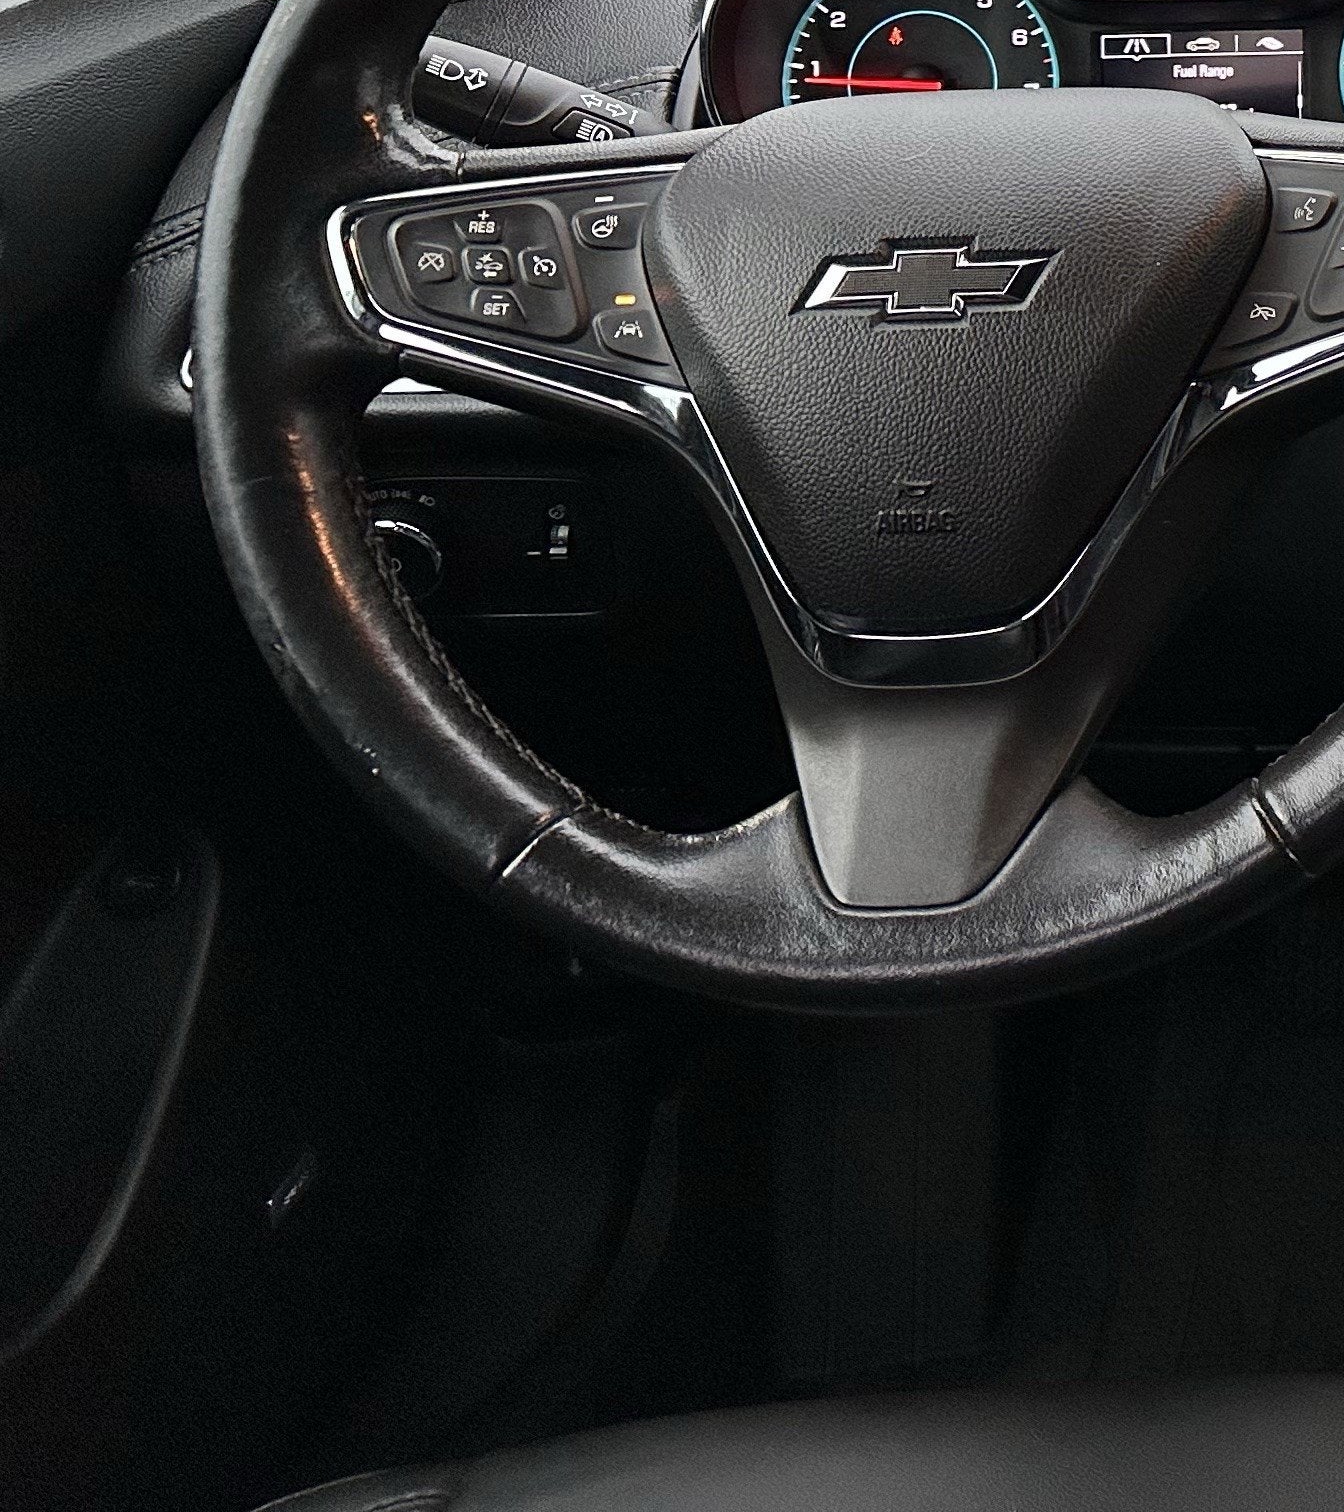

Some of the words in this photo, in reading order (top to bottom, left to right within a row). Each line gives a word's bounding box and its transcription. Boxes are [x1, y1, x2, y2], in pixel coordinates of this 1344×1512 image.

[829, 11, 846, 28] 2
[1010, 28, 1028, 46] 6
[810, 60, 820, 77] 1
[1172, 64, 1198, 79] Fuel
[1199, 64, 1235, 80] Range
[468, 220, 495, 235] RES
[482, 302, 510, 317] SET
